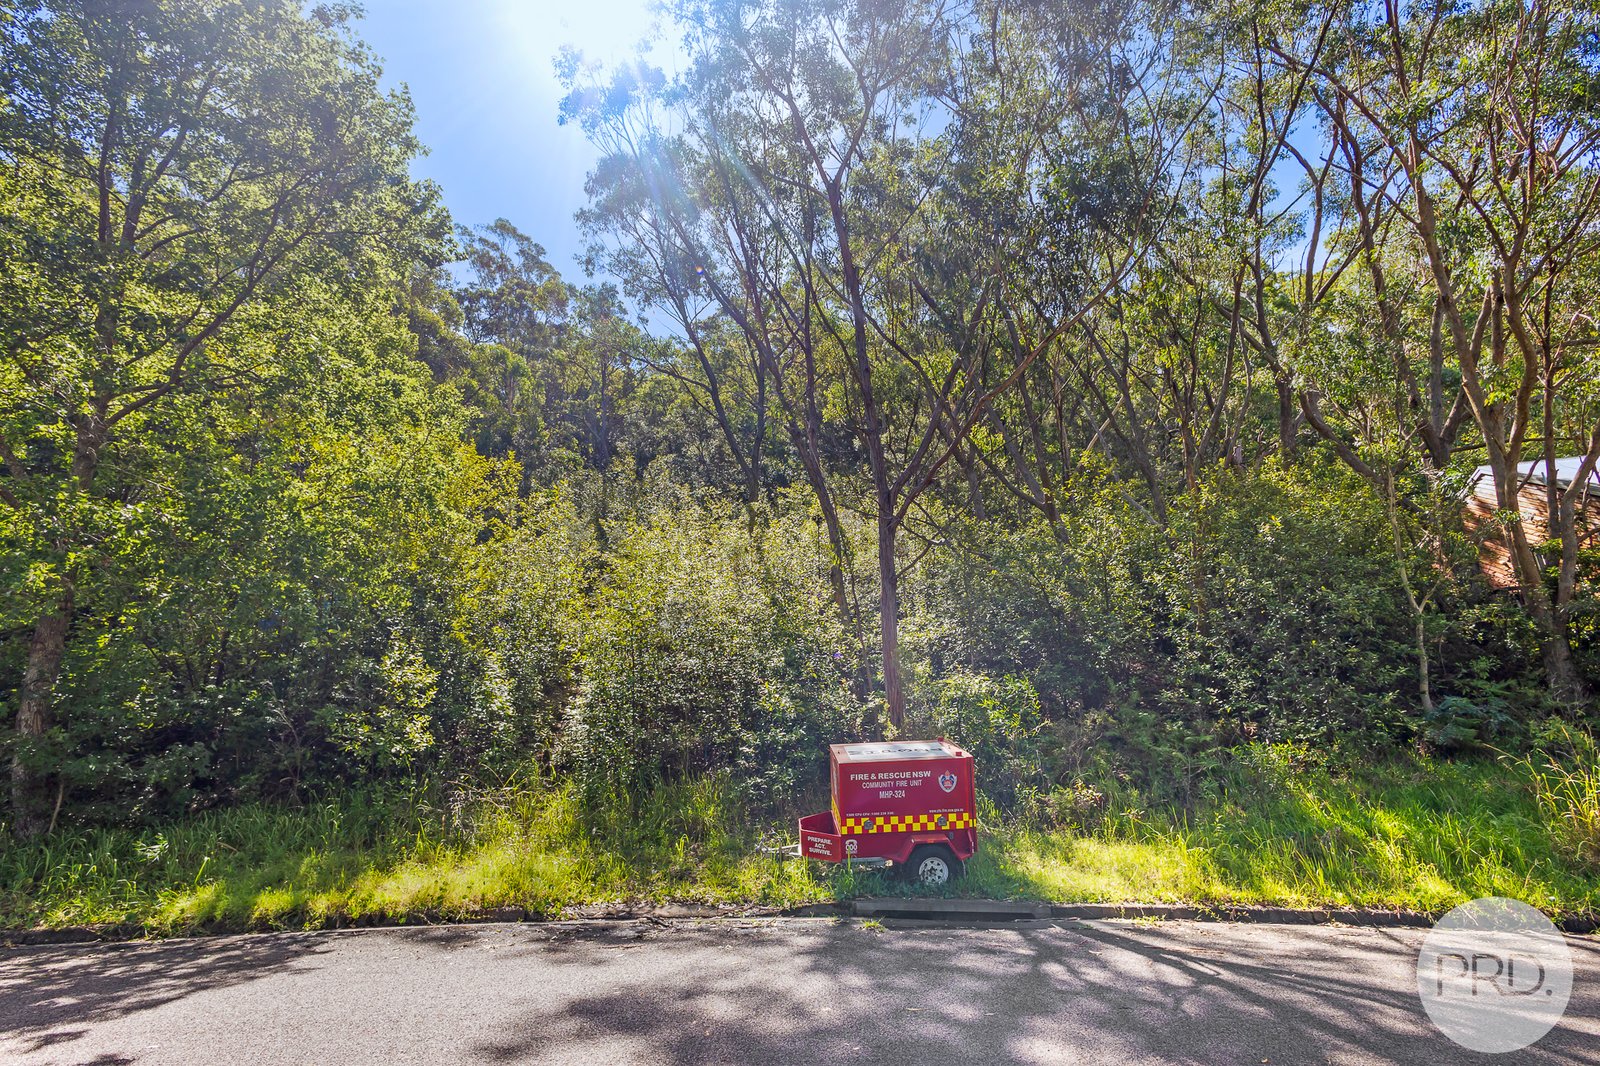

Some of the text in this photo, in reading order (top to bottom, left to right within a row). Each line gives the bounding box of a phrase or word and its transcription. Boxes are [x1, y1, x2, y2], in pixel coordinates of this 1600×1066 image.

[912, 770, 931, 778] NSW
[862, 781, 894, 789] COMMUNITY
[879, 790, 905, 799] MHP-324
